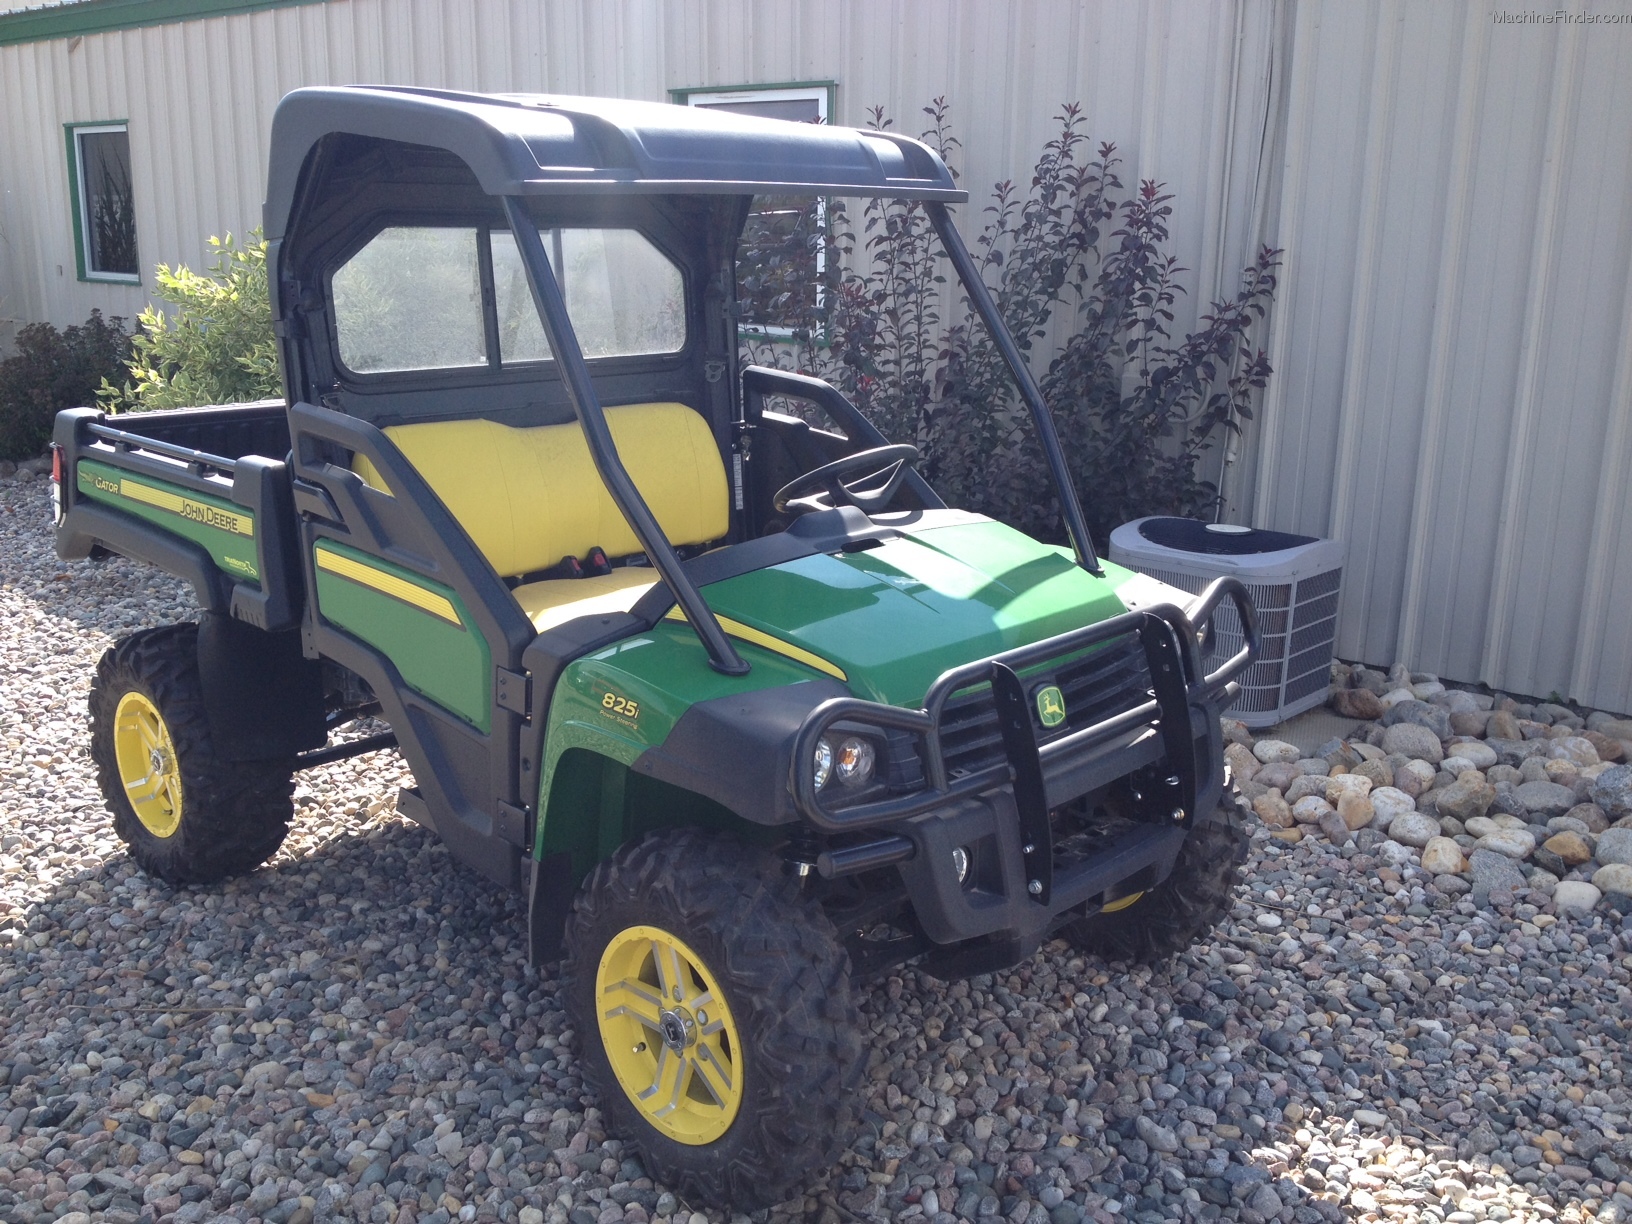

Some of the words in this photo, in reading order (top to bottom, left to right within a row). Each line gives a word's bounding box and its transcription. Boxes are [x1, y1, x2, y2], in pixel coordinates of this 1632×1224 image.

[95, 476, 119, 494] GATOR
[180, 499, 205, 521] JOHN
[206, 506, 238, 531] DEERE
[601, 692, 640, 719] 825i
